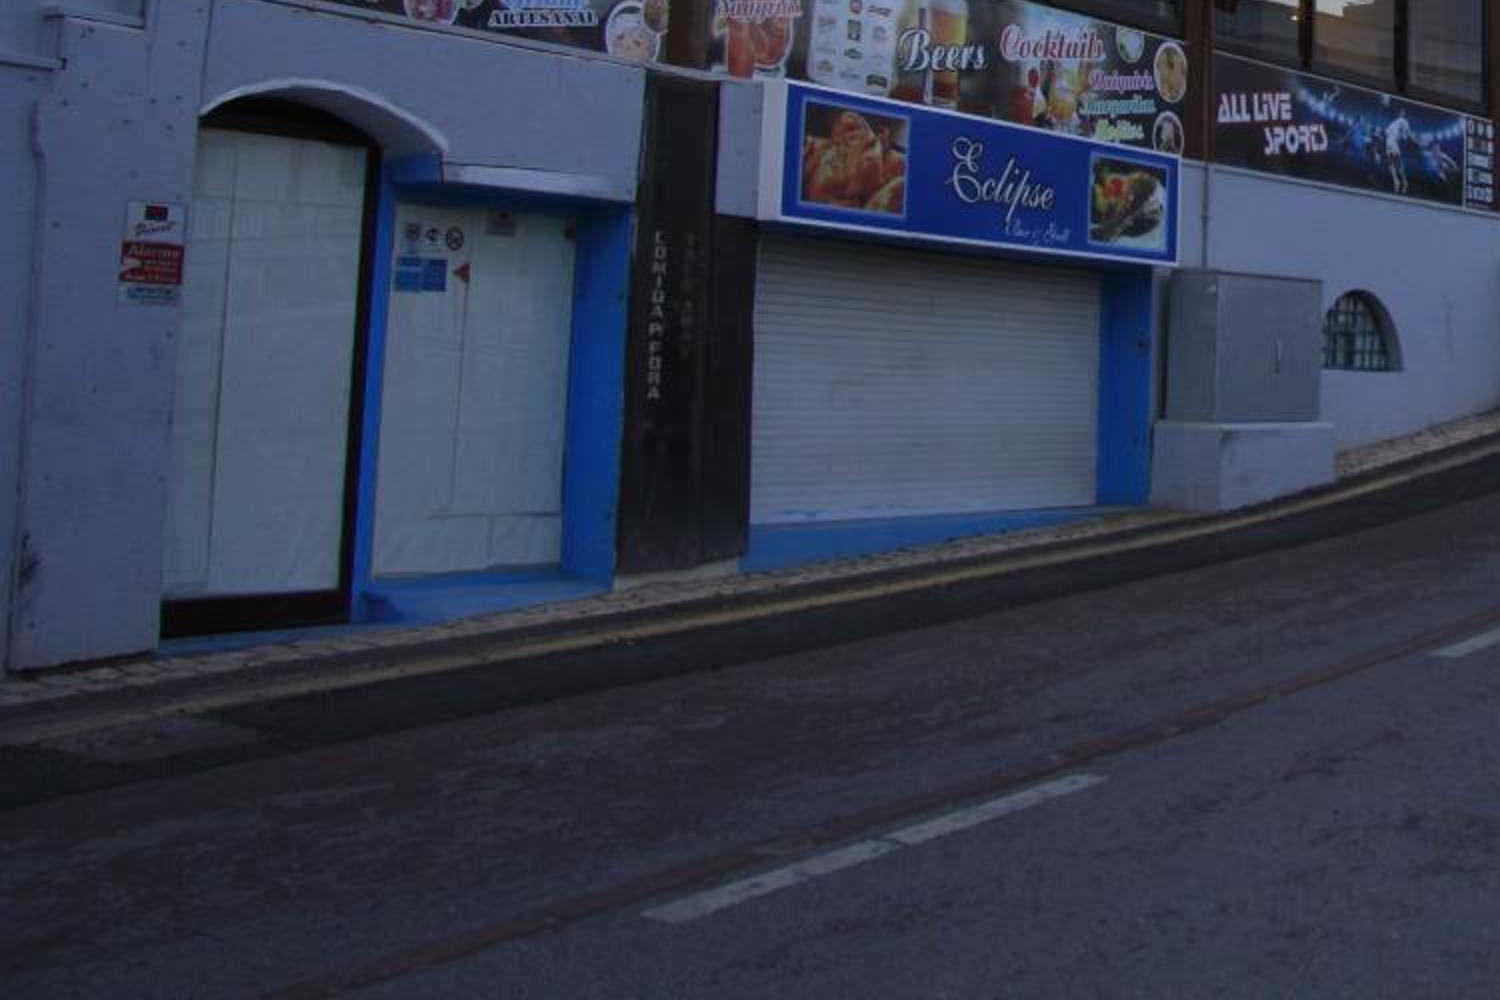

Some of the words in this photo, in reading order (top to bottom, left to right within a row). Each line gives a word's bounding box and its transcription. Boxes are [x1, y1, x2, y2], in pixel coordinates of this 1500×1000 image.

[899, 26, 989, 72] Beers
[1000, 24, 1106, 62] Cocktails
[1217, 94, 1250, 123] ALL
[945, 137, 1056, 223] Eclipse
